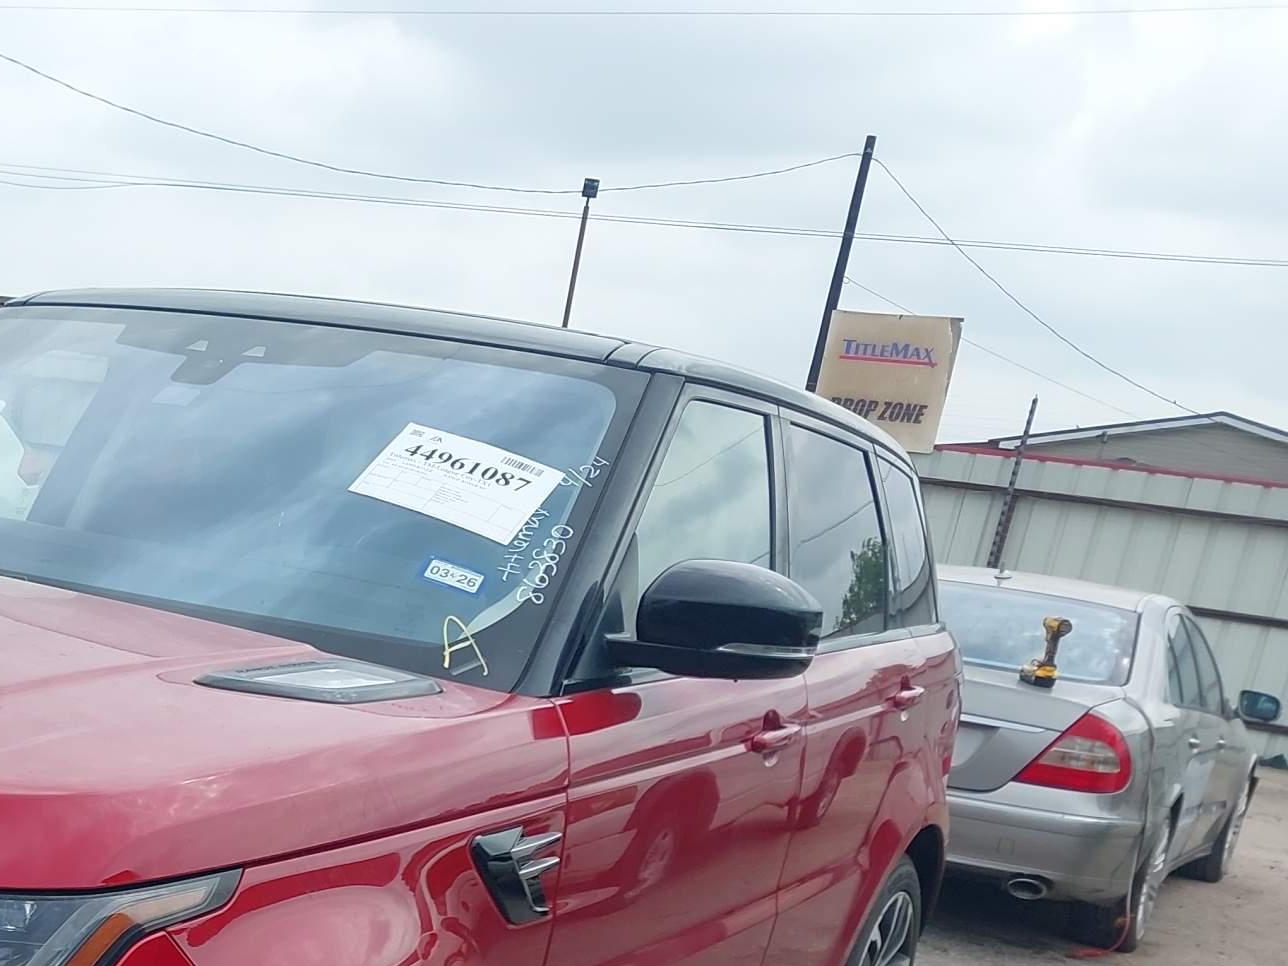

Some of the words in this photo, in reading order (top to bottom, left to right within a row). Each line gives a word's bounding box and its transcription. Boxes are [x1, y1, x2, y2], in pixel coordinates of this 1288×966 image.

[877, 402, 928, 425] ZONE
[404, 444, 532, 492] 44961087
[516, 523, 574, 605] 863830
